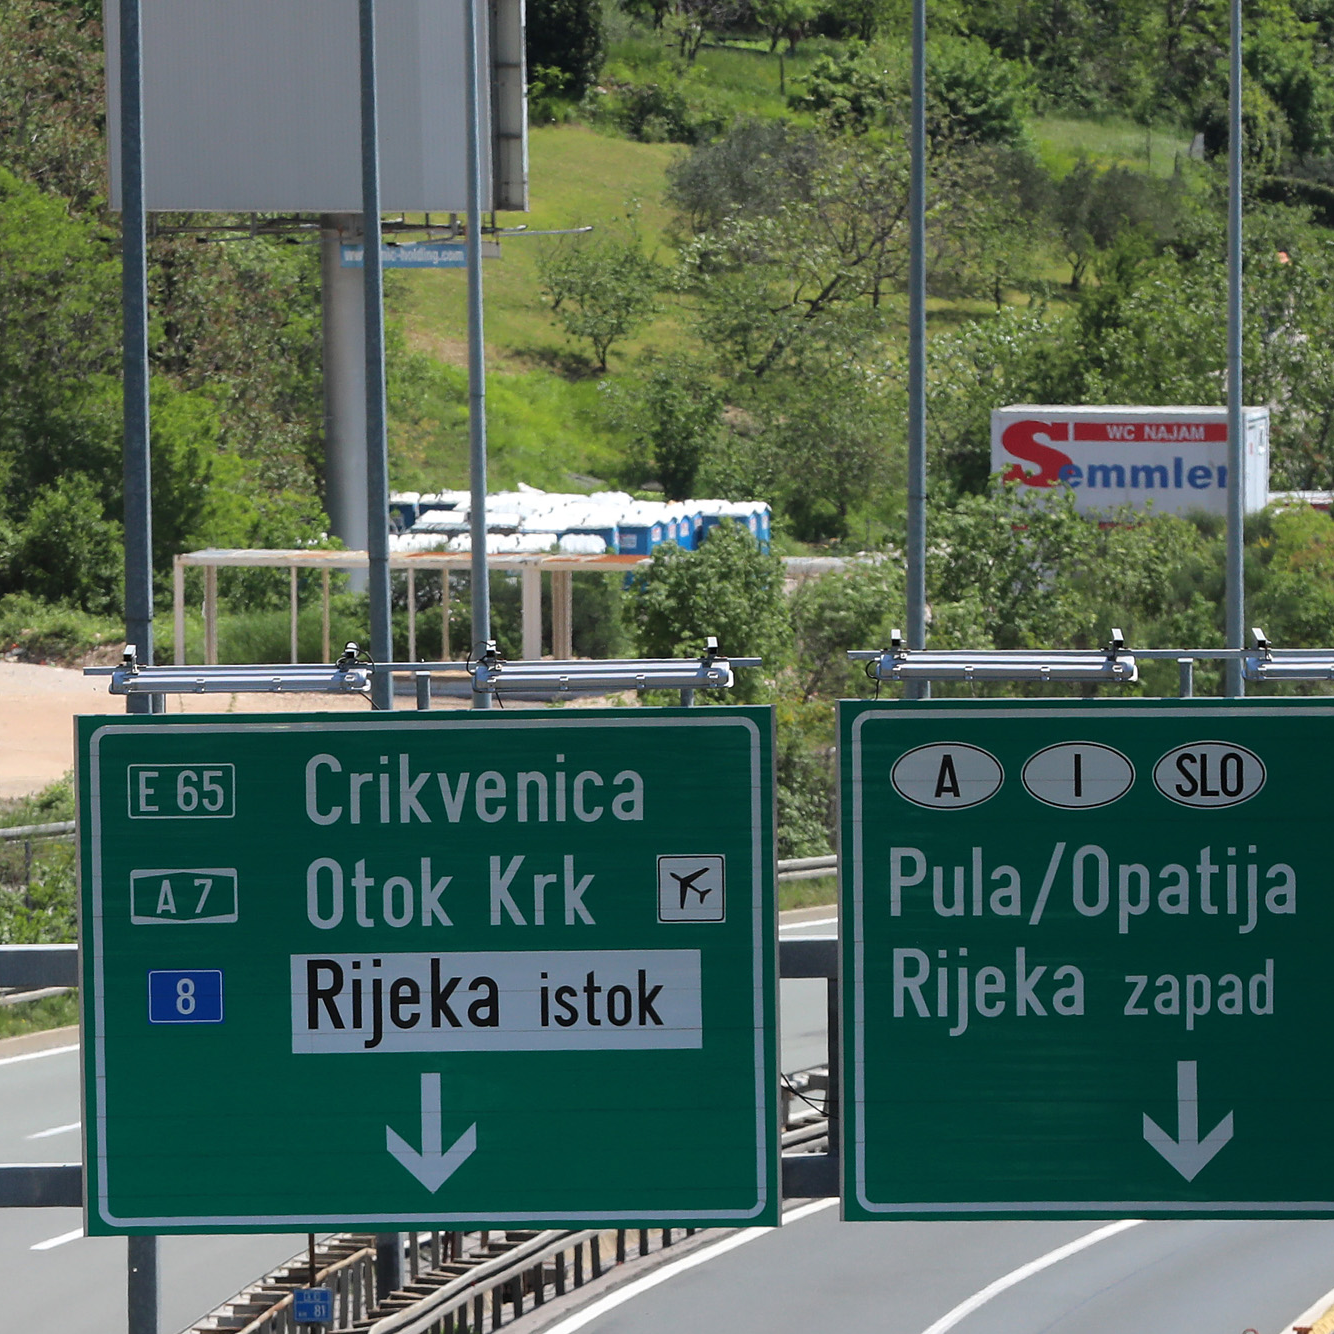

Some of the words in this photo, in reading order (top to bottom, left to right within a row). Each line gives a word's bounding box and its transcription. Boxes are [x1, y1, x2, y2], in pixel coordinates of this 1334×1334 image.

[1106, 424, 1135, 440] WC
[1143, 424, 1205, 440] NAJAM
[138, 770, 159, 813] E
[175, 769, 225, 813] 65
[304, 752, 645, 826] Crikvenica
[933, 753, 961, 799] A
[1073, 753, 1083, 798] I
[1174, 751, 1244, 798] SLO
[156, 877, 177, 915] A
[193, 876, 213, 915] 7
[305, 856, 454, 930] Otok
[489, 854, 597, 927] Krk
[889, 842, 1297, 935] Pula/Opatija
[174, 977, 197, 1016] 8
[306, 957, 500, 1050] Rijeka
[539, 968, 665, 1028] istok
[892, 946, 1086, 1037] Rijeka
[1123, 958, 1275, 1031] zapad
[314, 1303, 326, 1318] 81
